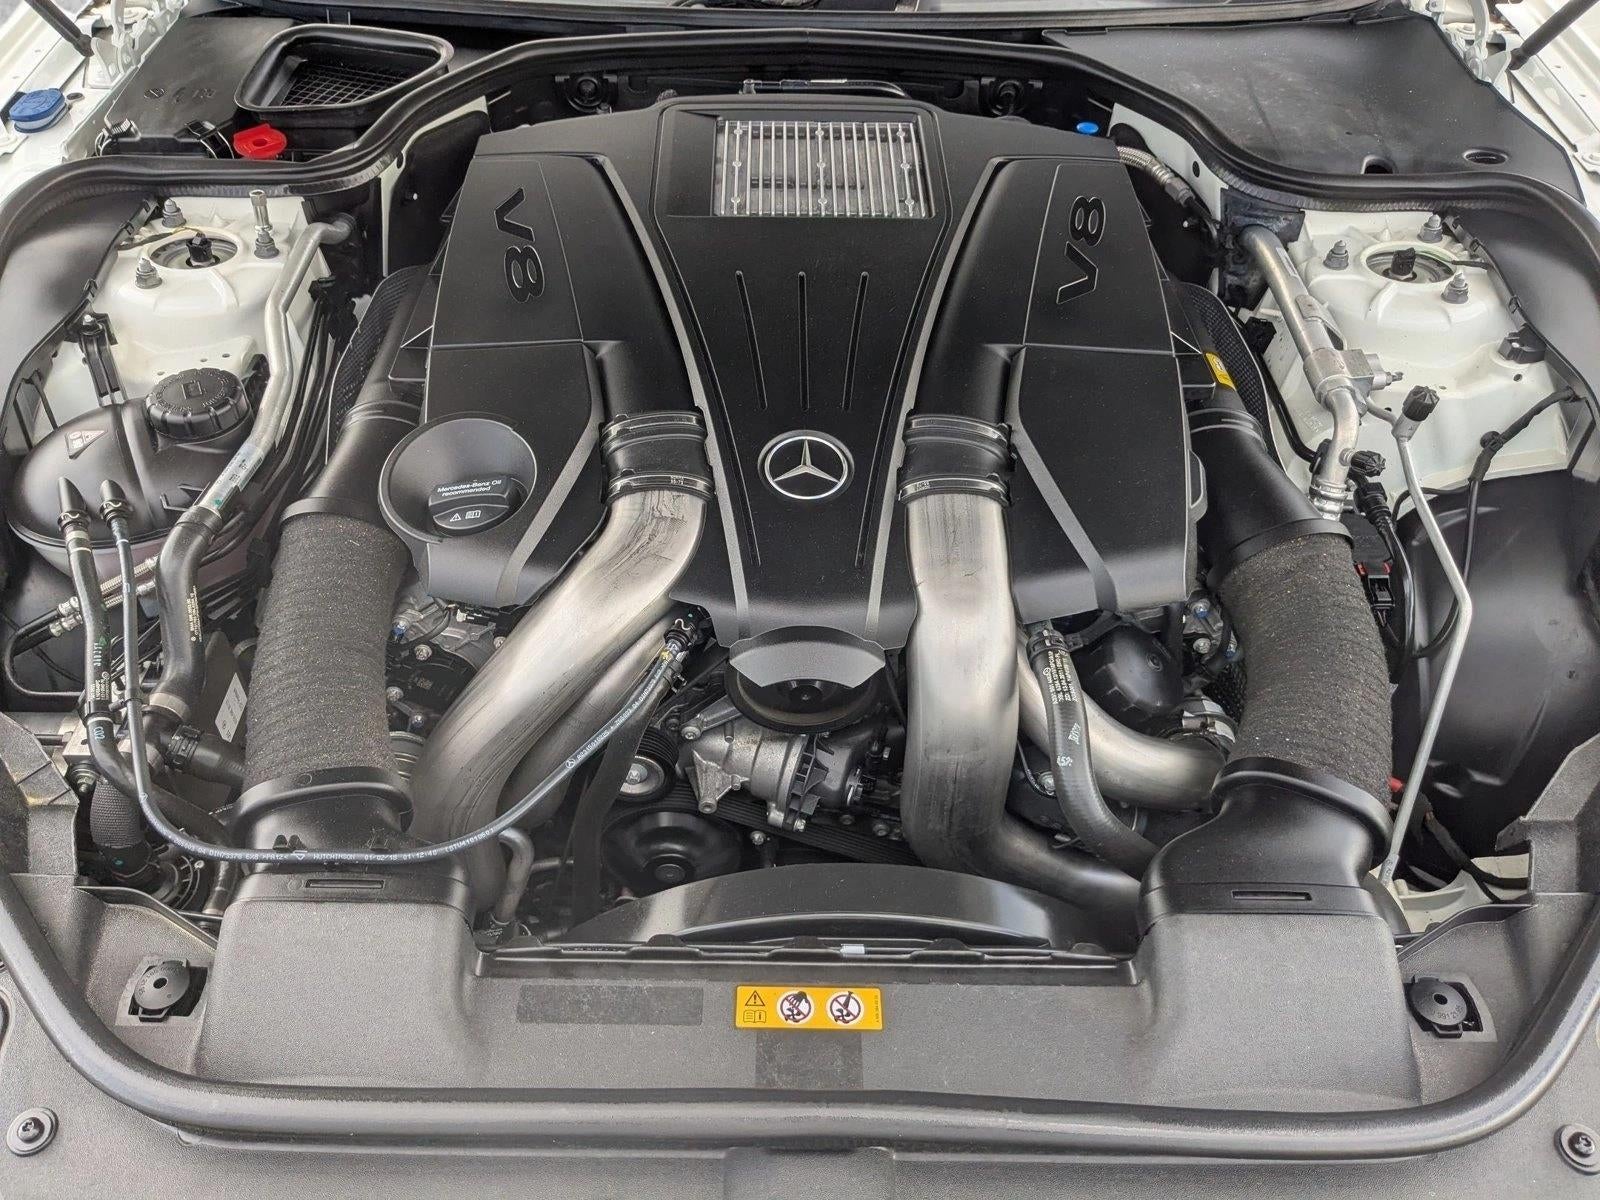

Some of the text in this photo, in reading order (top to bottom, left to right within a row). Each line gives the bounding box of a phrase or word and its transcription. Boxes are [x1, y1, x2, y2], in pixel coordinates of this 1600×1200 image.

[494, 187, 545, 303] V8
[1056, 195, 1106, 305] V8
[437, 481, 490, 493] Mercedes-Benz
[442, 486, 491, 497] recommended
